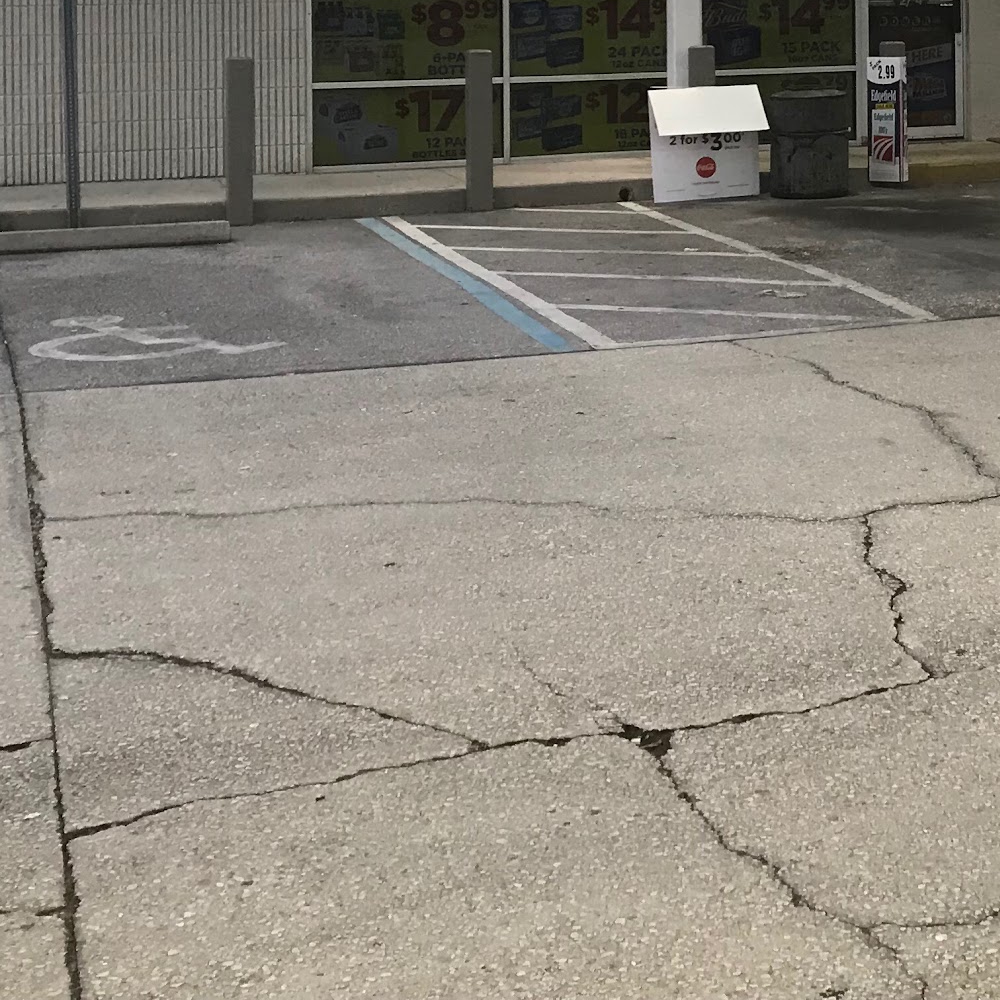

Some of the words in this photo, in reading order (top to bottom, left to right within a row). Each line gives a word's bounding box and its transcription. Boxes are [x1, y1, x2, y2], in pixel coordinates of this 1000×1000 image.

[608, 47, 626, 58] 24
[781, 42, 797, 53] 15
[800, 40, 841, 53] PACK
[433, 52, 465, 63] 6-PA
[427, 65, 465, 76] BOTT
[878, 64, 895, 80] 2.99
[870, 89, 897, 104] Edgefield
[631, 127, 650, 139] PA
[426, 136, 440, 148] 12
[444, 136, 466, 148] PA
[669, 135, 677, 146] 2
[680, 135, 698, 145] for
